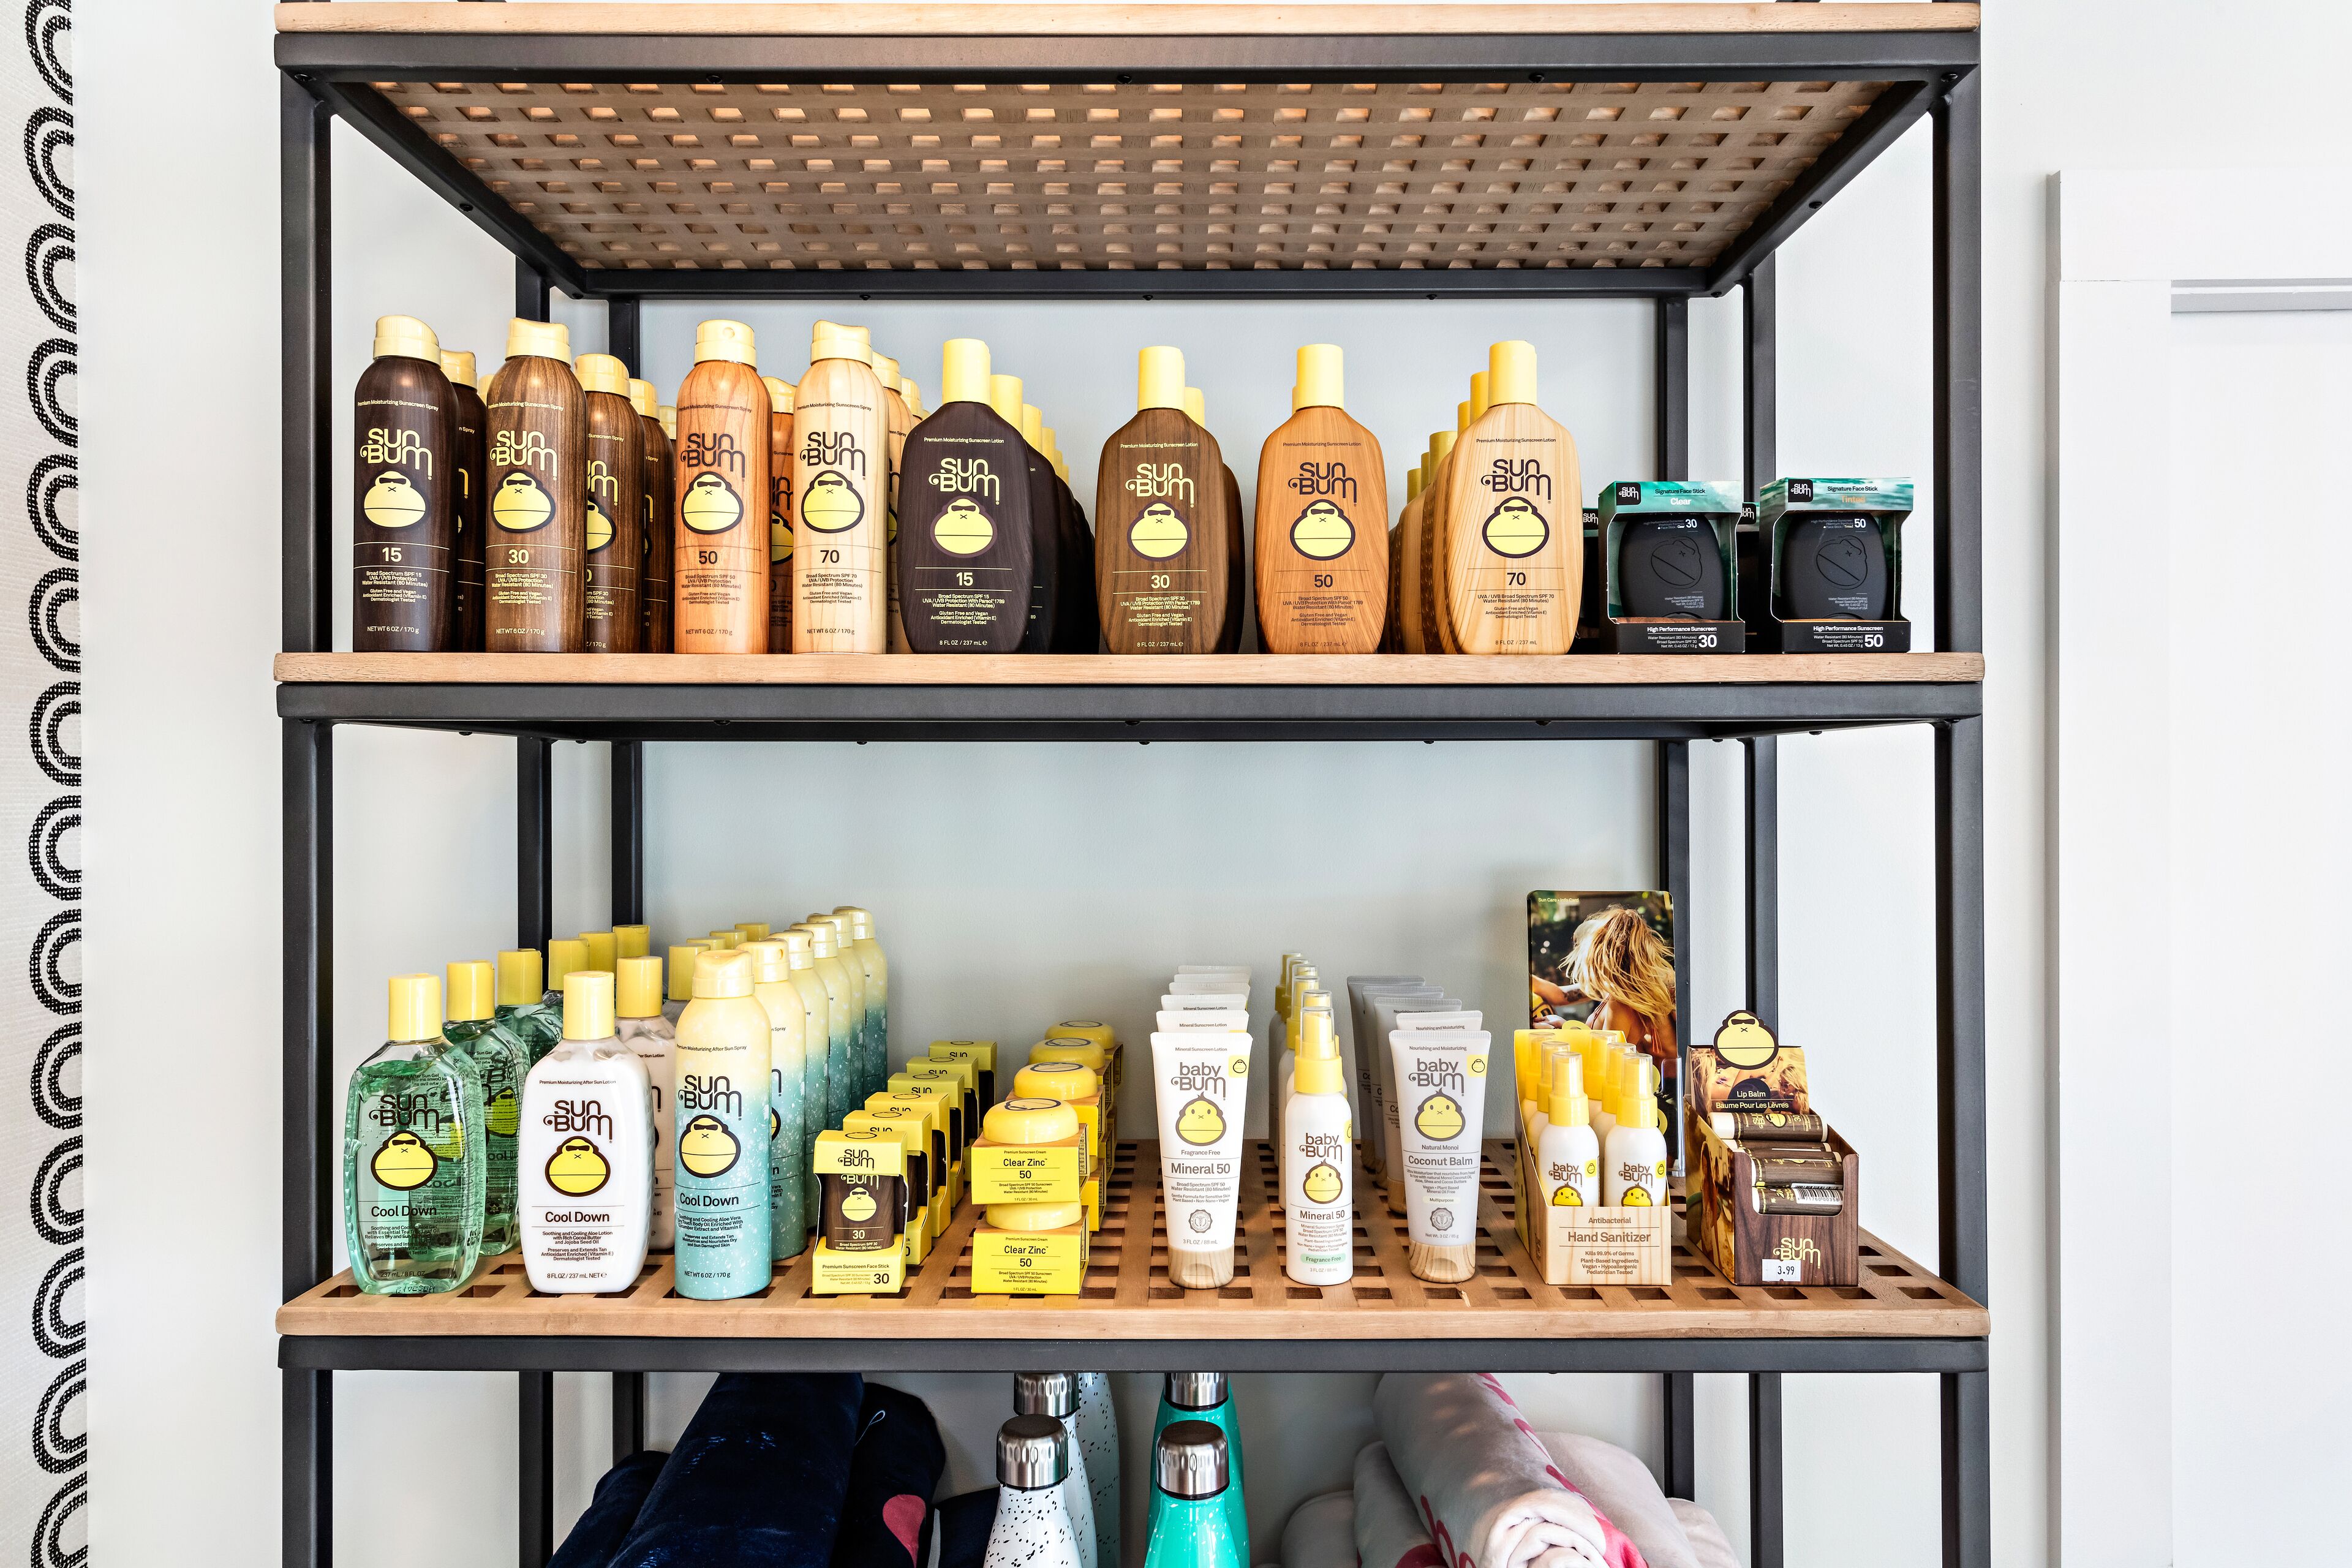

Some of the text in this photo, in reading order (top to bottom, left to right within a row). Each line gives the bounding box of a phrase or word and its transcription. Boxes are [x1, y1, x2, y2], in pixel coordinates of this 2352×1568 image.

[1686, 519, 1697, 528] 30
[1854, 519, 1866, 528] 50
[382, 548, 402, 562] 15
[508, 549, 529, 564] 30
[699, 551, 718, 564] 50
[820, 550, 840, 564] 70
[956, 572, 973, 586] 15
[1151, 575, 1170, 589] 30
[1314, 575, 1333, 588] 50
[1507, 573, 1526, 586] 70
[1698, 635, 1717, 648] 30
[1864, 635, 1883, 647] 50
[1180, 1062, 1221, 1077] baby
[1417, 1058, 1458, 1073] baby
[1306, 1133, 1340, 1145] baby
[1409, 1156, 1472, 1166] Coconut Balm
[1171, 1163, 1231, 1174] Mineral 50
[1553, 1162, 1579, 1172] baby
[1624, 1162, 1650, 1172] baby
[1019, 1170, 1031, 1179] 50
[680, 1193, 739, 1207] Cool Down
[371, 1206, 437, 1217] Cool Down
[1300, 1210, 1345, 1220] Mineral 50
[546, 1212, 610, 1223] Cool Down
[853, 1230, 865, 1240] 30
[1568, 1232, 1651, 1242] Hand Sanitizer
[1005, 1246, 1026, 1254] Clear
[1020, 1259, 1031, 1267] 50
[1777, 1266, 1795, 1275] 3.99
[873, 1273, 889, 1284] 30
